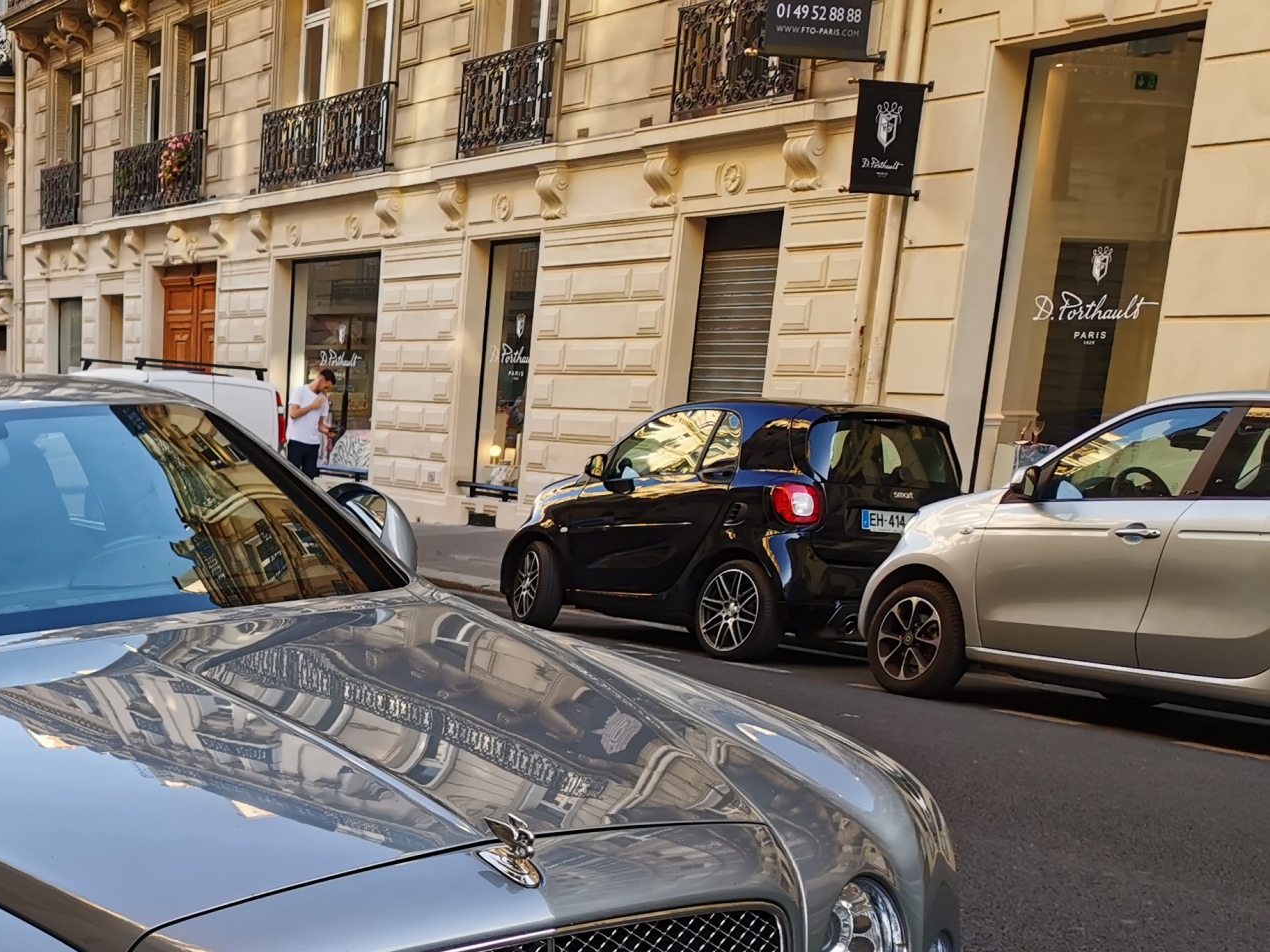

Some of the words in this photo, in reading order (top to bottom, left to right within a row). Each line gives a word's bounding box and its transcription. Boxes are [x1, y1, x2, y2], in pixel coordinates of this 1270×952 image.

[776, 3, 791, 18] 01
[793, 4, 809, 19] 49
[811, 5, 827, 20] 52
[829, 7, 845, 22] 88
[846, 8, 862, 23] 88
[776, 25, 860, 37] WWW.FTO-PARIS.COM
[1032, 295, 1055, 321] D.
[1058, 291, 1159, 321] Porthault
[1073, 331, 1107, 339] PARIS
[893, 491, 914, 499] smart
